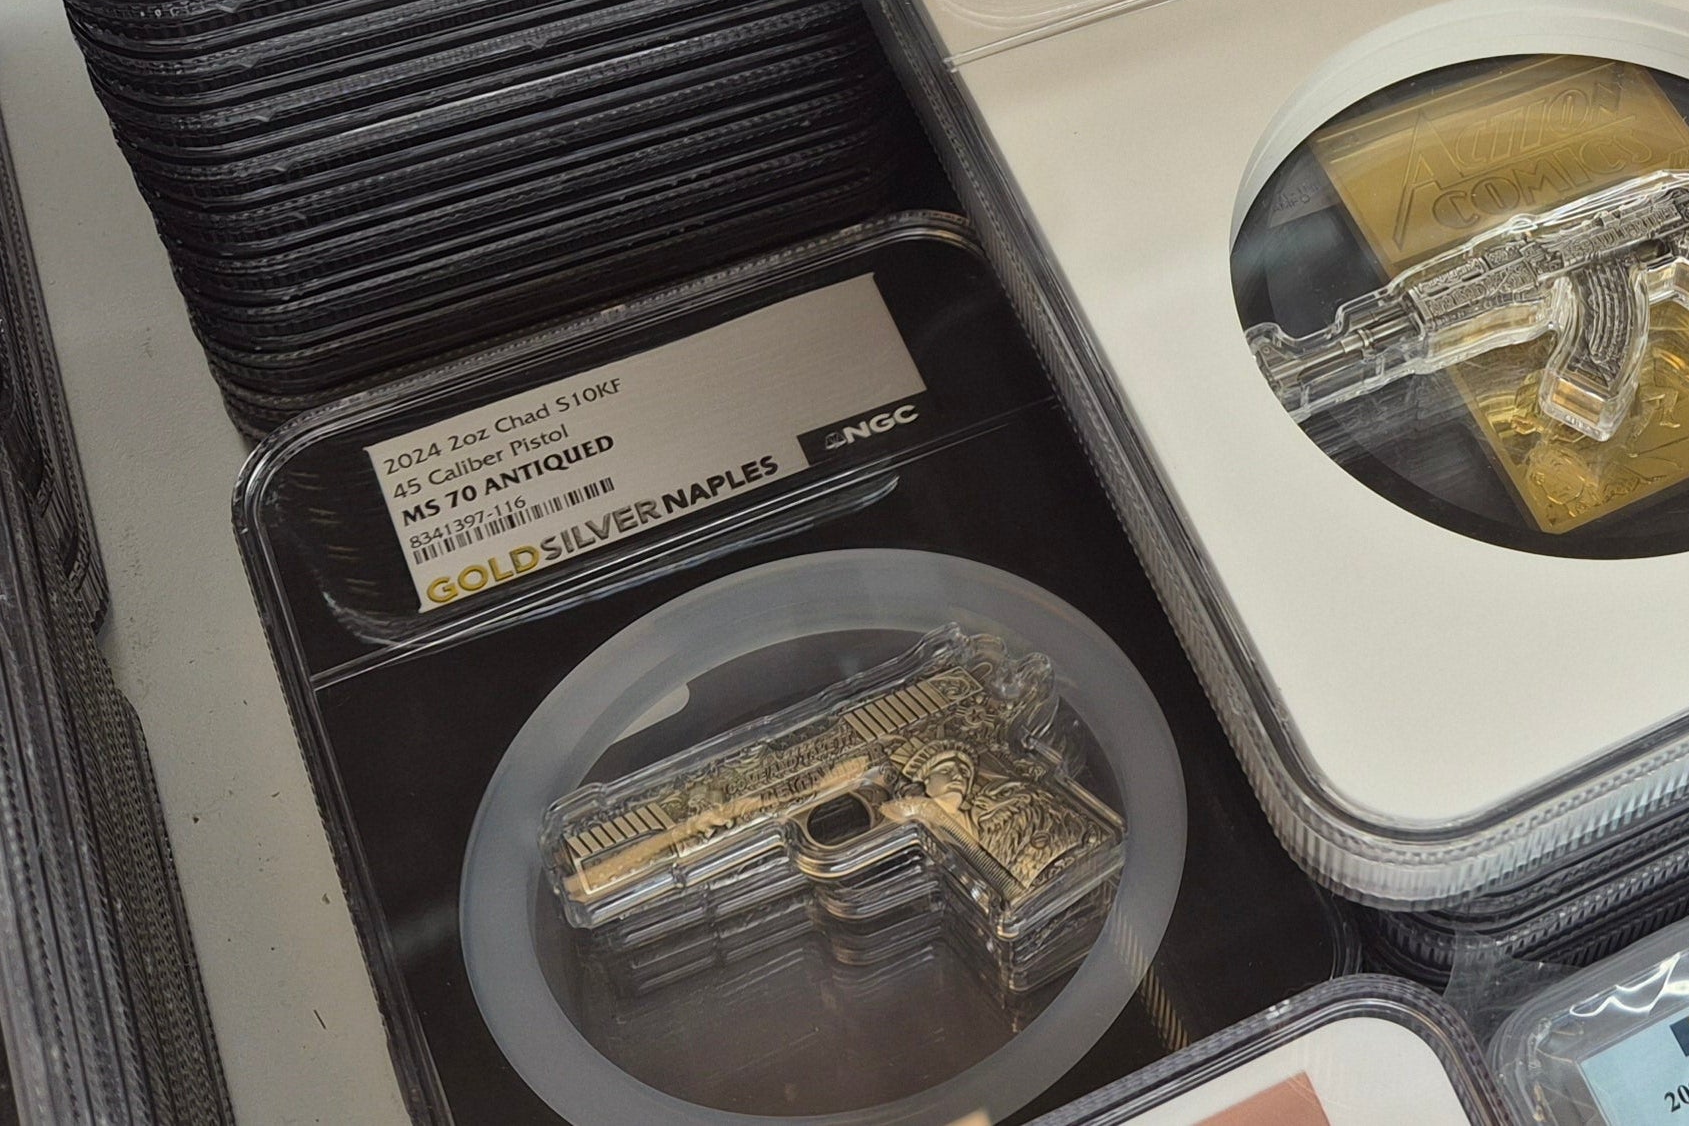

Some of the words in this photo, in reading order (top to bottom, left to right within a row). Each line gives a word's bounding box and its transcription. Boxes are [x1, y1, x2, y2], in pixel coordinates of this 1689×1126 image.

[1432, 129, 1652, 228] COMICS
[383, 443, 443, 475] 2024
[447, 429, 490, 451] 2oz
[494, 404, 550, 432] Chad
[555, 378, 622, 412] S10KF
[393, 478, 422, 499] 45
[428, 449, 504, 485] Caliber
[509, 424, 569, 456] Pistol
[843, 404, 919, 445] NGC
[402, 498, 441, 526] MS
[445, 485, 478, 508] 70
[485, 435, 614, 495] ANTIQUED
[410, 495, 527, 549] 8341397-116
[426, 455, 779, 604] GOLDSILVERNAPLES
